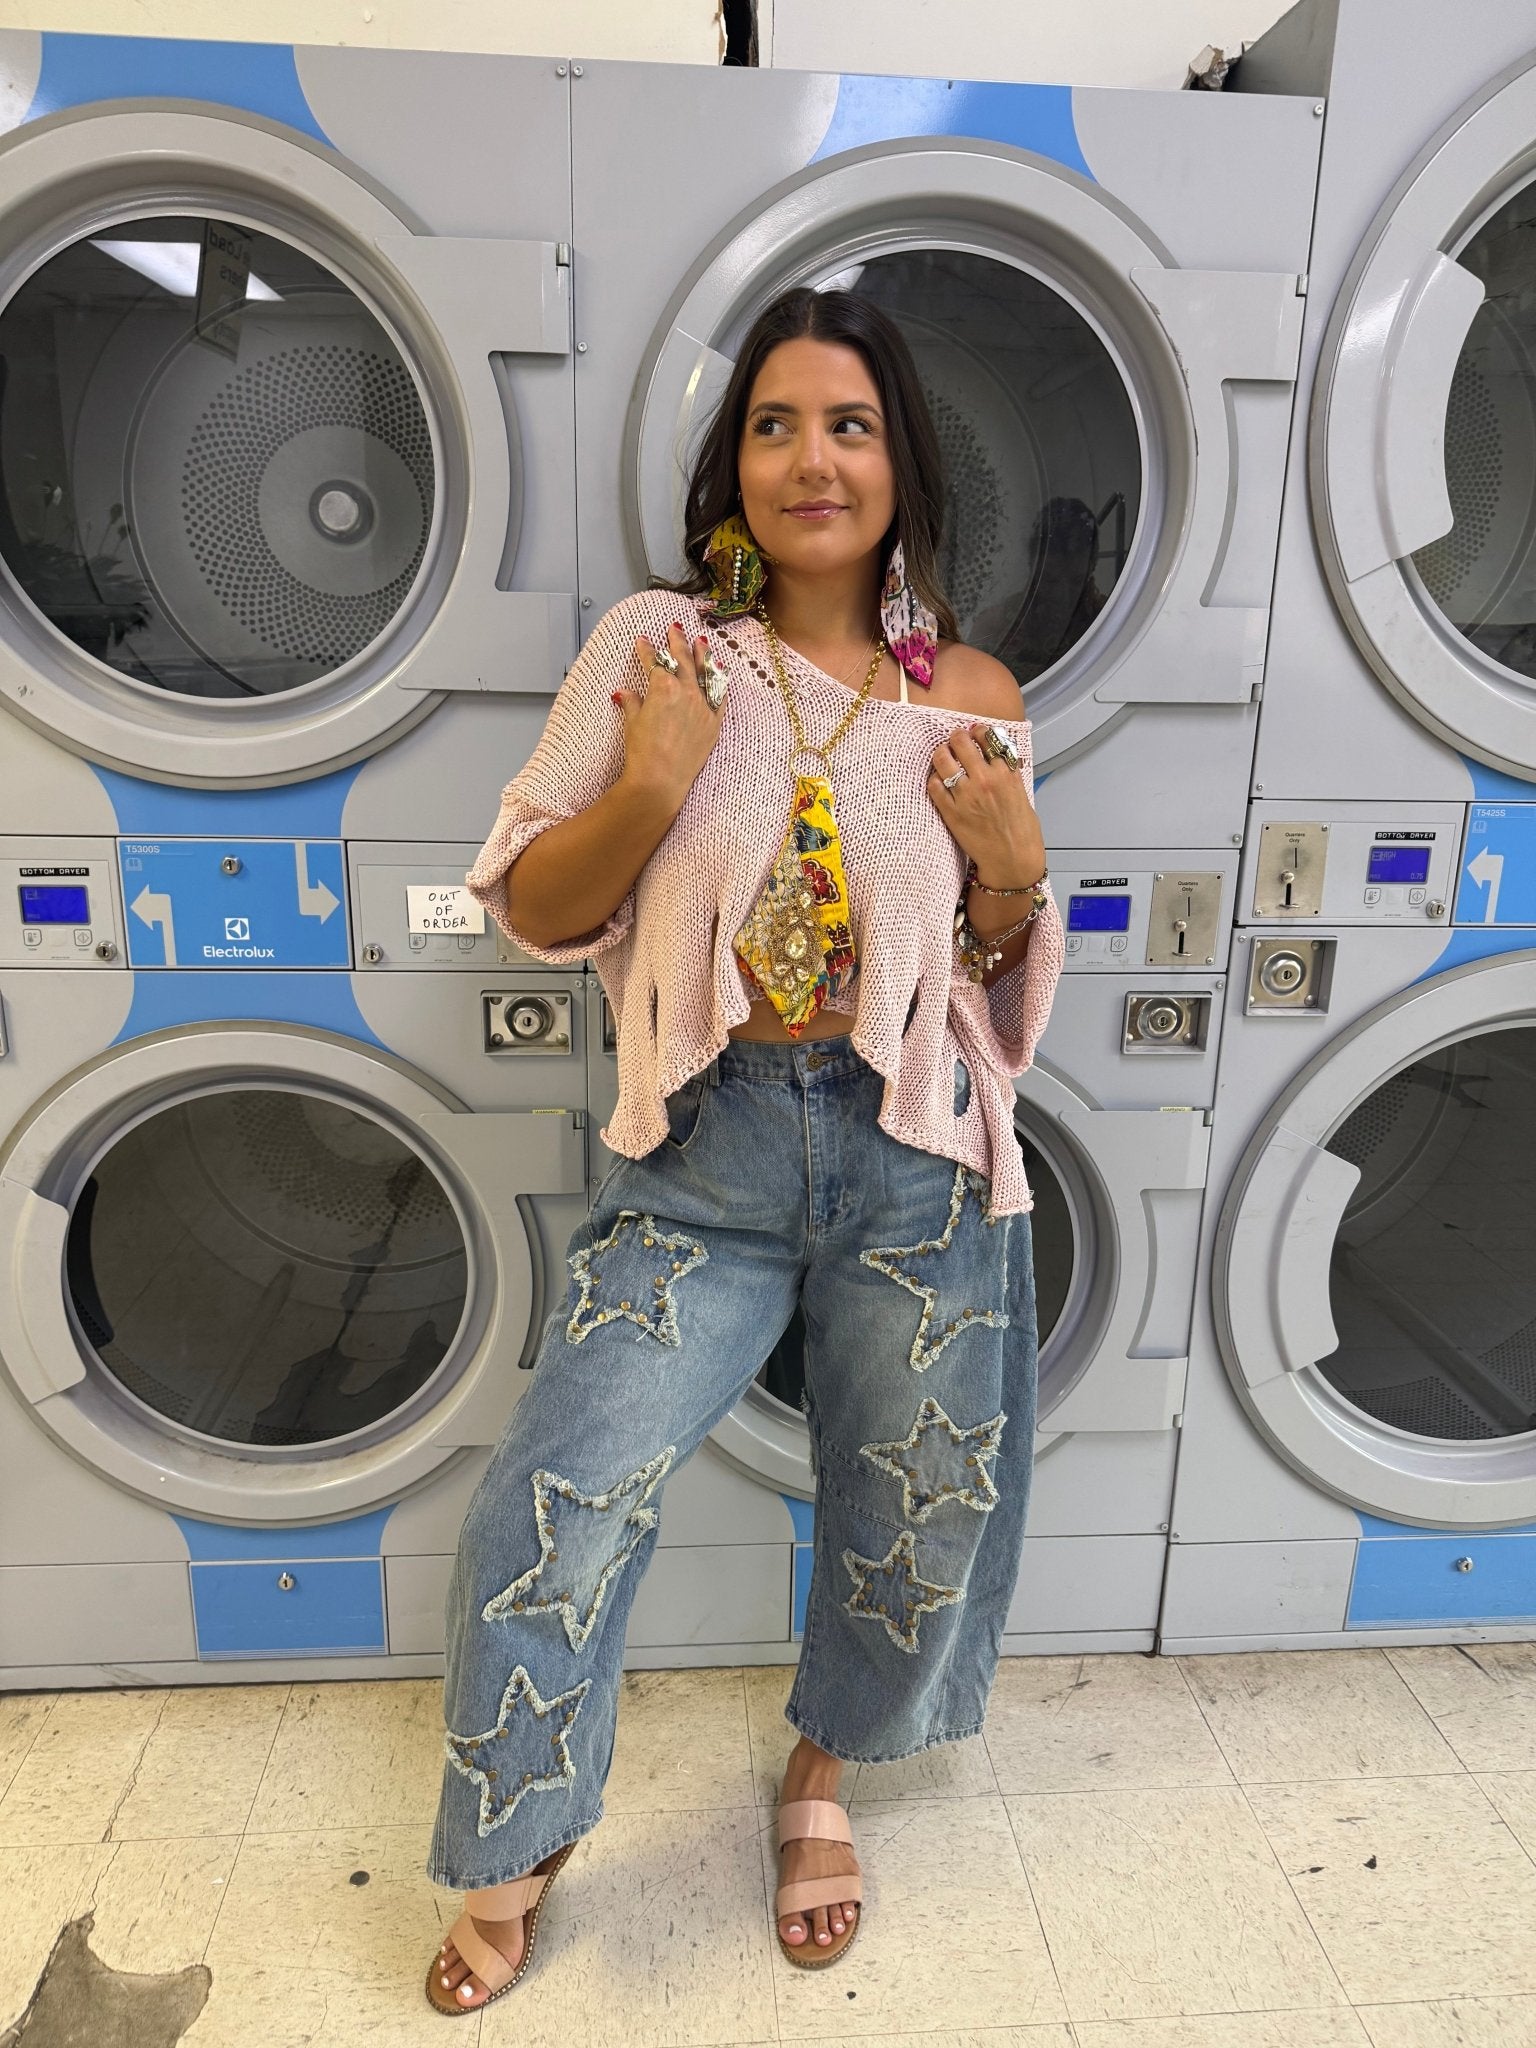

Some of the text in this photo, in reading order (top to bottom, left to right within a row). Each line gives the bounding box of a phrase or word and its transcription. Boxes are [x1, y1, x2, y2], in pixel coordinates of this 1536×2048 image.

[1476, 808, 1506, 817] T5425S
[125, 844, 161, 854] T5300S
[1101, 878, 1126, 886] DRYER
[428, 890, 461, 902] OUT
[435, 904, 453, 916] OF
[423, 915, 469, 929] ORDER
[203, 945, 276, 958] Electrolux
